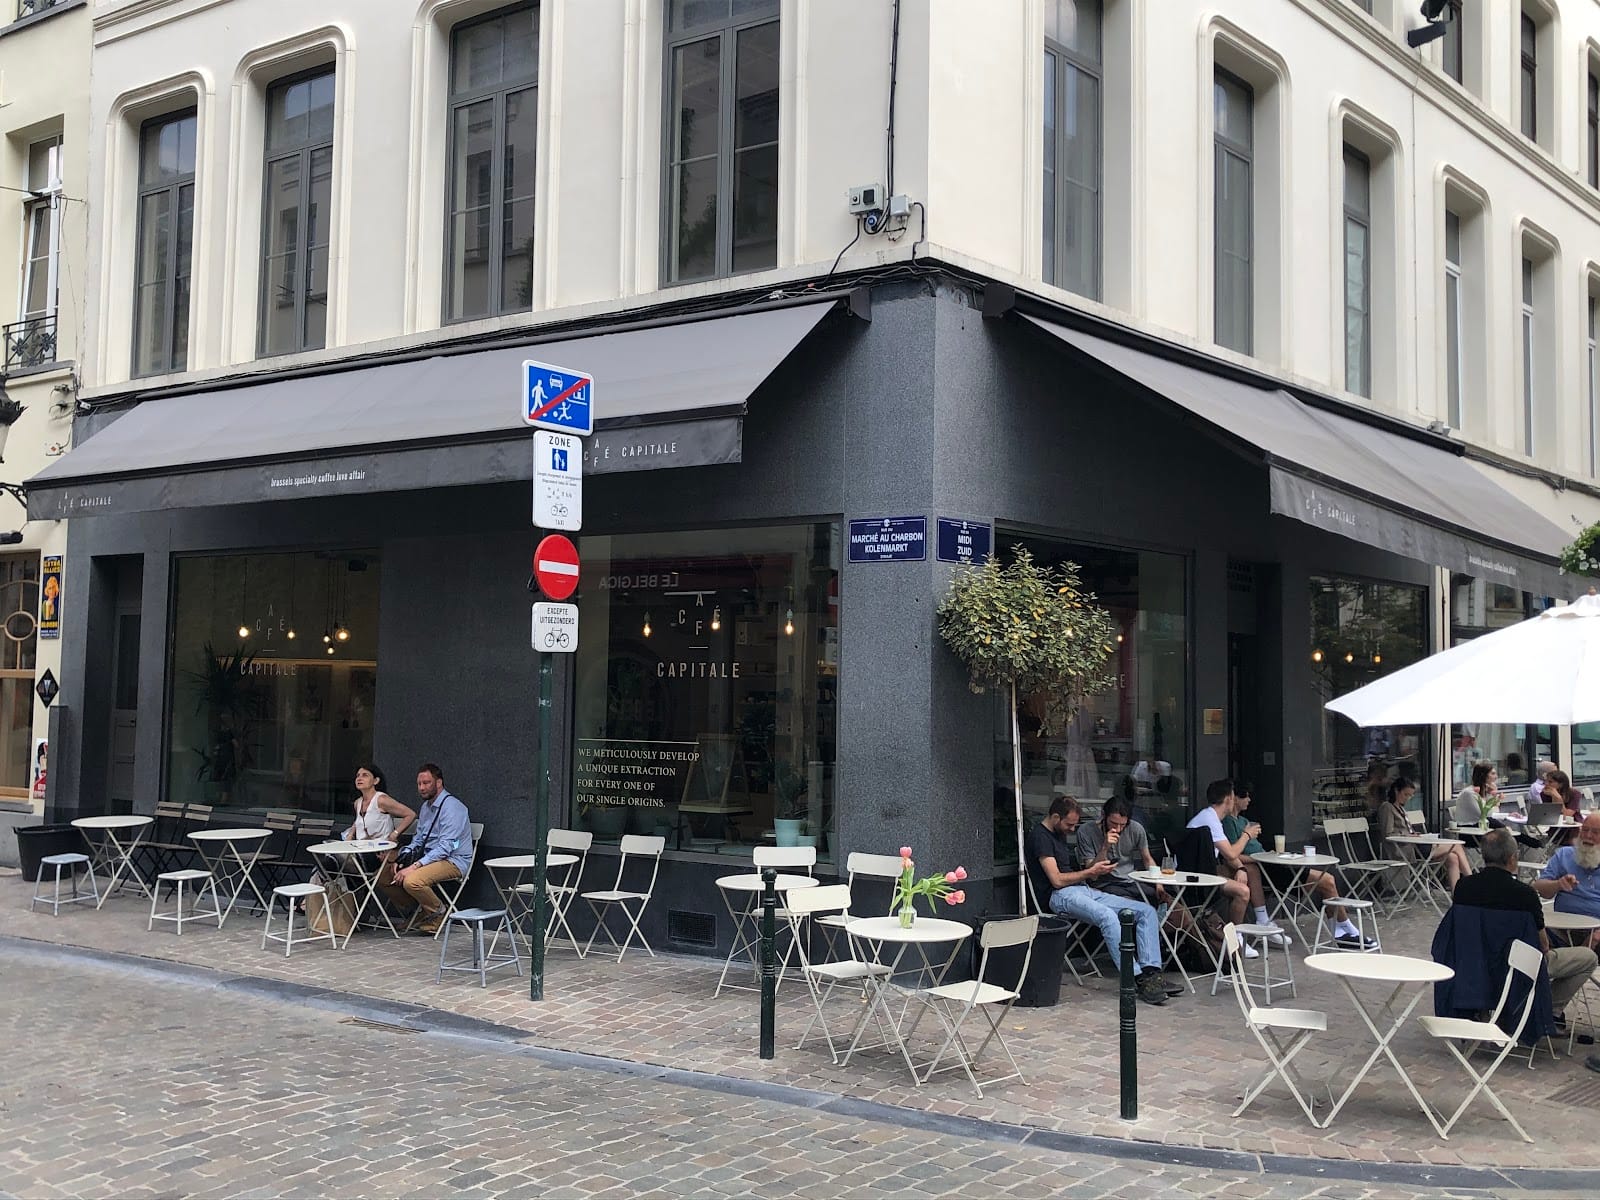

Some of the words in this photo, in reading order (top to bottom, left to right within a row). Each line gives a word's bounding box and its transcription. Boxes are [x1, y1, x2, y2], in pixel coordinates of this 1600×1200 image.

[549, 436, 571, 448] ZONE
[621, 442, 677, 458] CAPITALE
[80, 496, 112, 507] CAPITALE
[852, 532, 878, 543] MARCHÉ
[880, 533, 889, 542] AU
[890, 532, 923, 542] CHARBON
[957, 534, 972, 545] MIDI
[864, 543, 908, 553] KOLENMARKT
[957, 545, 972, 556] ZUID
[240, 662, 296, 676] CAPITALE
[657, 662, 740, 678] CAPITALE
[578, 748, 591, 757] WE
[593, 749, 657, 760] METICULOUSLY
[659, 751, 700, 762] DEVELOP
[577, 763, 584, 772] A
[585, 763, 619, 774] UNIQUE
[620, 765, 677, 776] EXTRACTION
[577, 779, 594, 788] FOR
[595, 780, 621, 790] EVERY
[623, 781, 642, 791] ONE
[643, 782, 656, 791] OF
[576, 794, 594, 803] OUR
[596, 795, 626, 805] SINGLE
[627, 796, 666, 808] ORIGINS.
